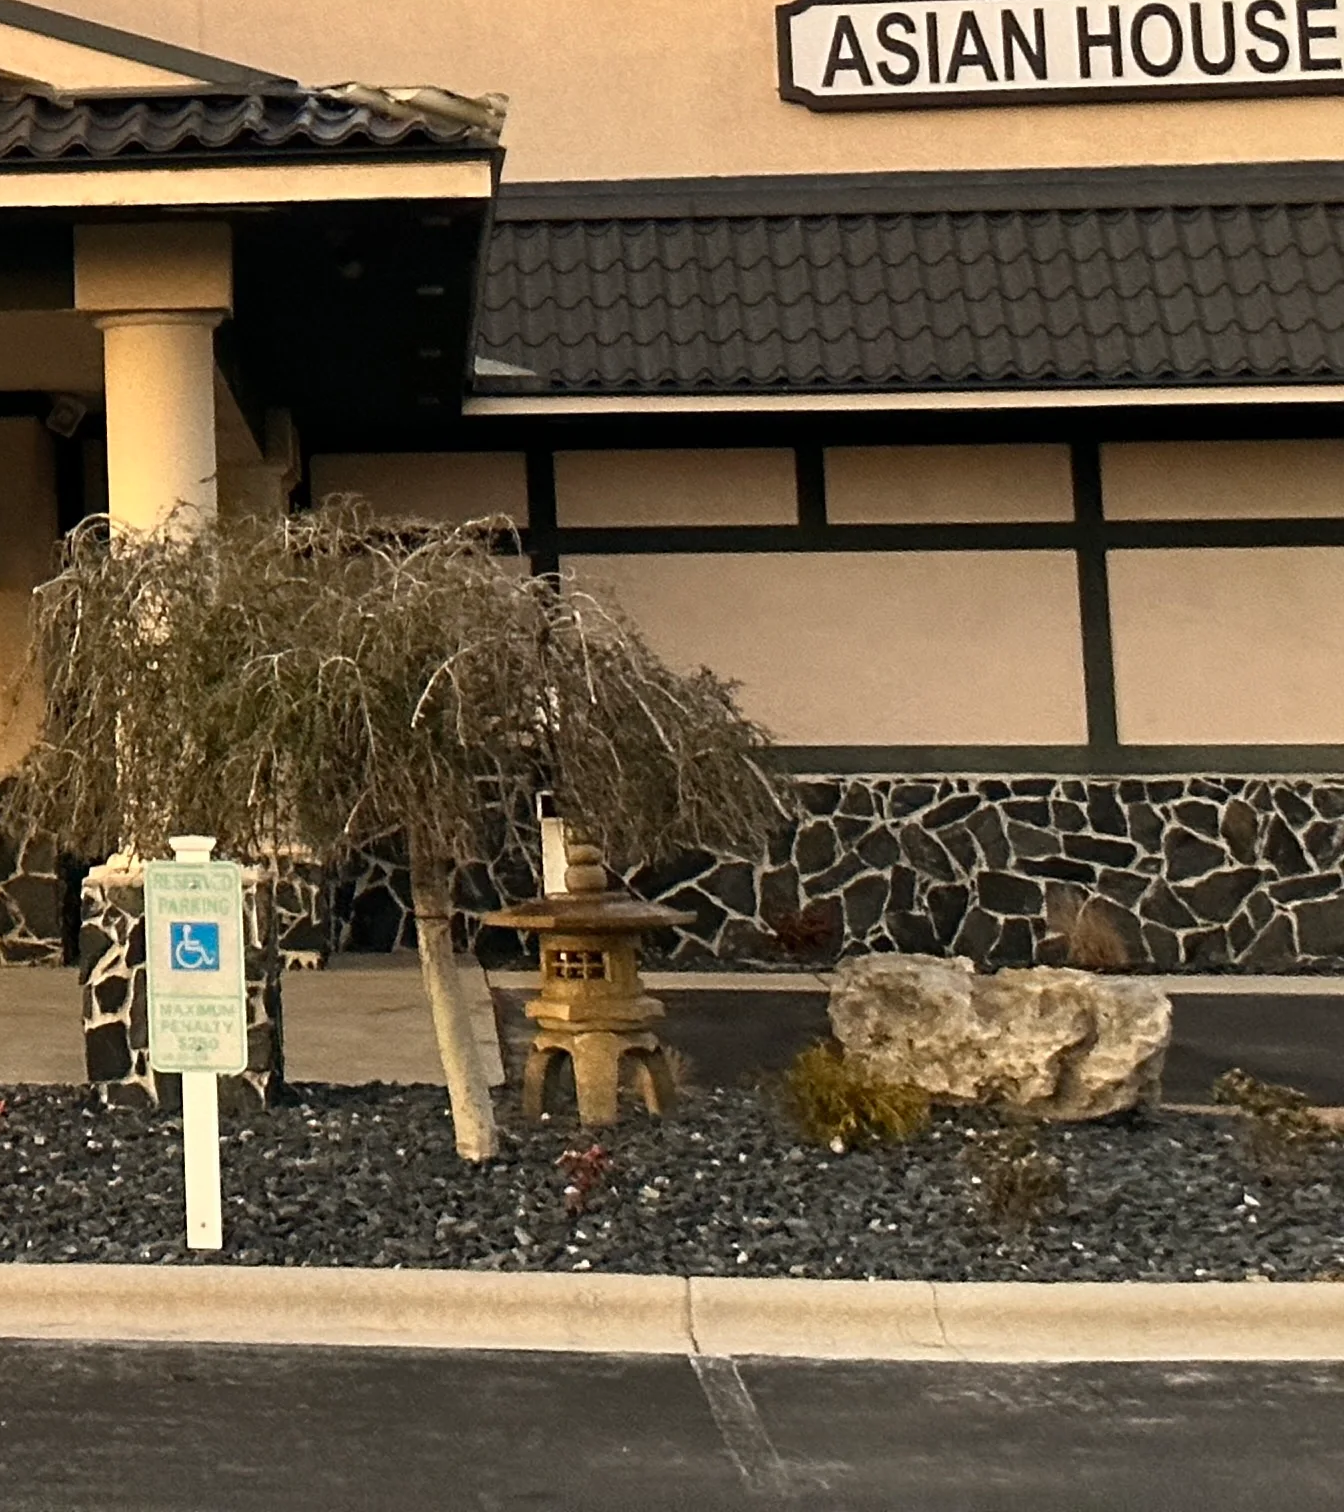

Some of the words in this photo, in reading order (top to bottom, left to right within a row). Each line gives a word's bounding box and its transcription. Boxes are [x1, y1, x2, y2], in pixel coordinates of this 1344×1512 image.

[821, 7, 1049, 89] ASIAN
[152, 872, 232, 891] RESERVED
[157, 895, 232, 917] PARKING
